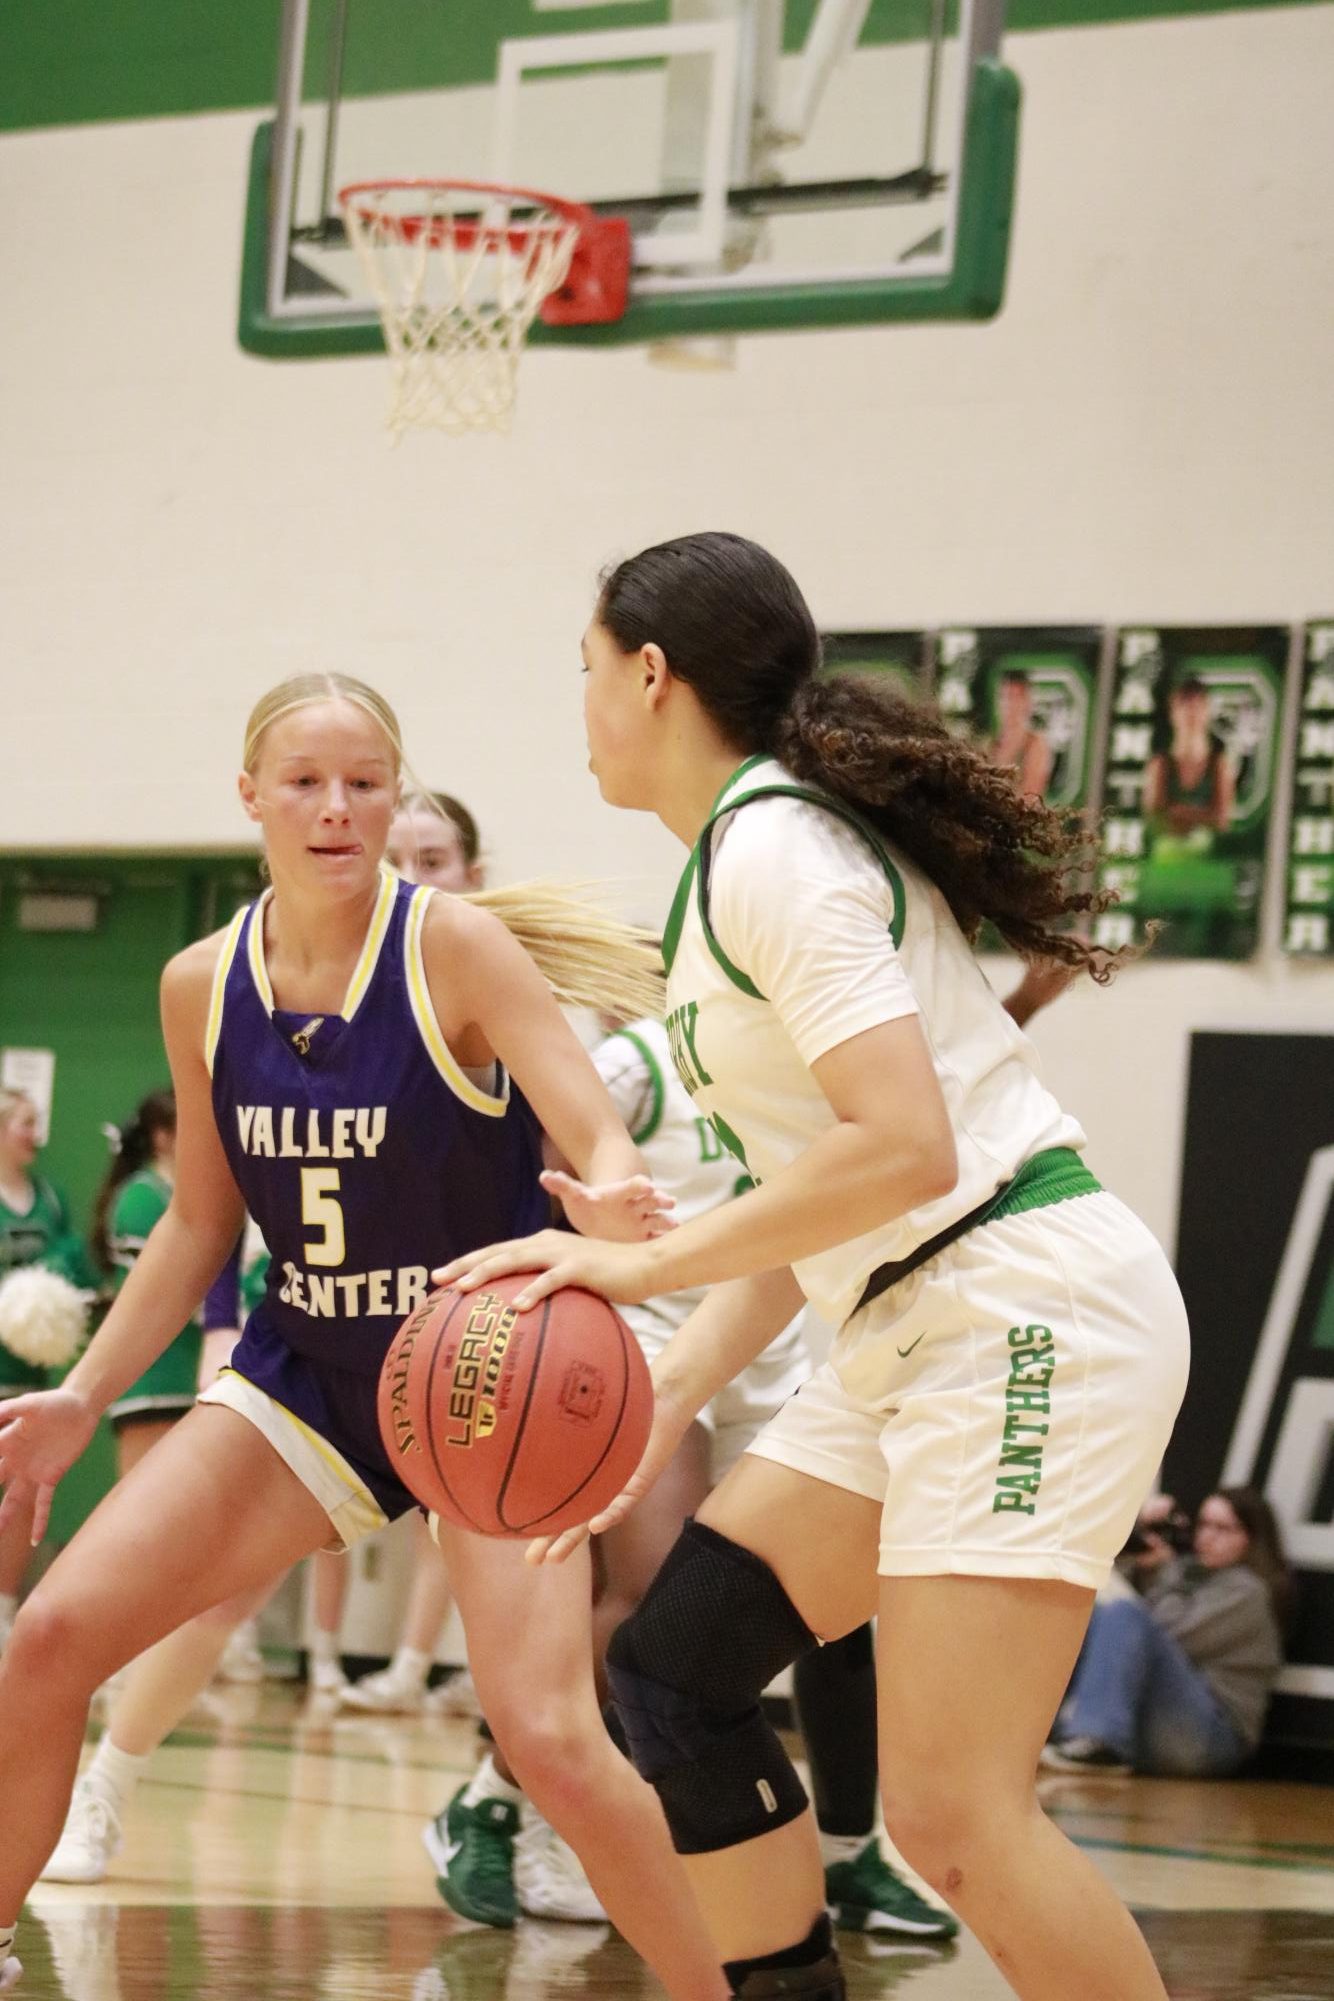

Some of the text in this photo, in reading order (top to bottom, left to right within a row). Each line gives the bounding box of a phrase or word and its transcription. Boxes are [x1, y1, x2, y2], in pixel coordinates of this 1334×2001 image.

[236, 1105, 388, 1158] VALLEY
[300, 1166, 346, 1267] 5
[446, 1292, 503, 1449] LEGACY
[480, 1305, 519, 1400] 1000
[992, 1323, 1056, 1516] PANTHERS
